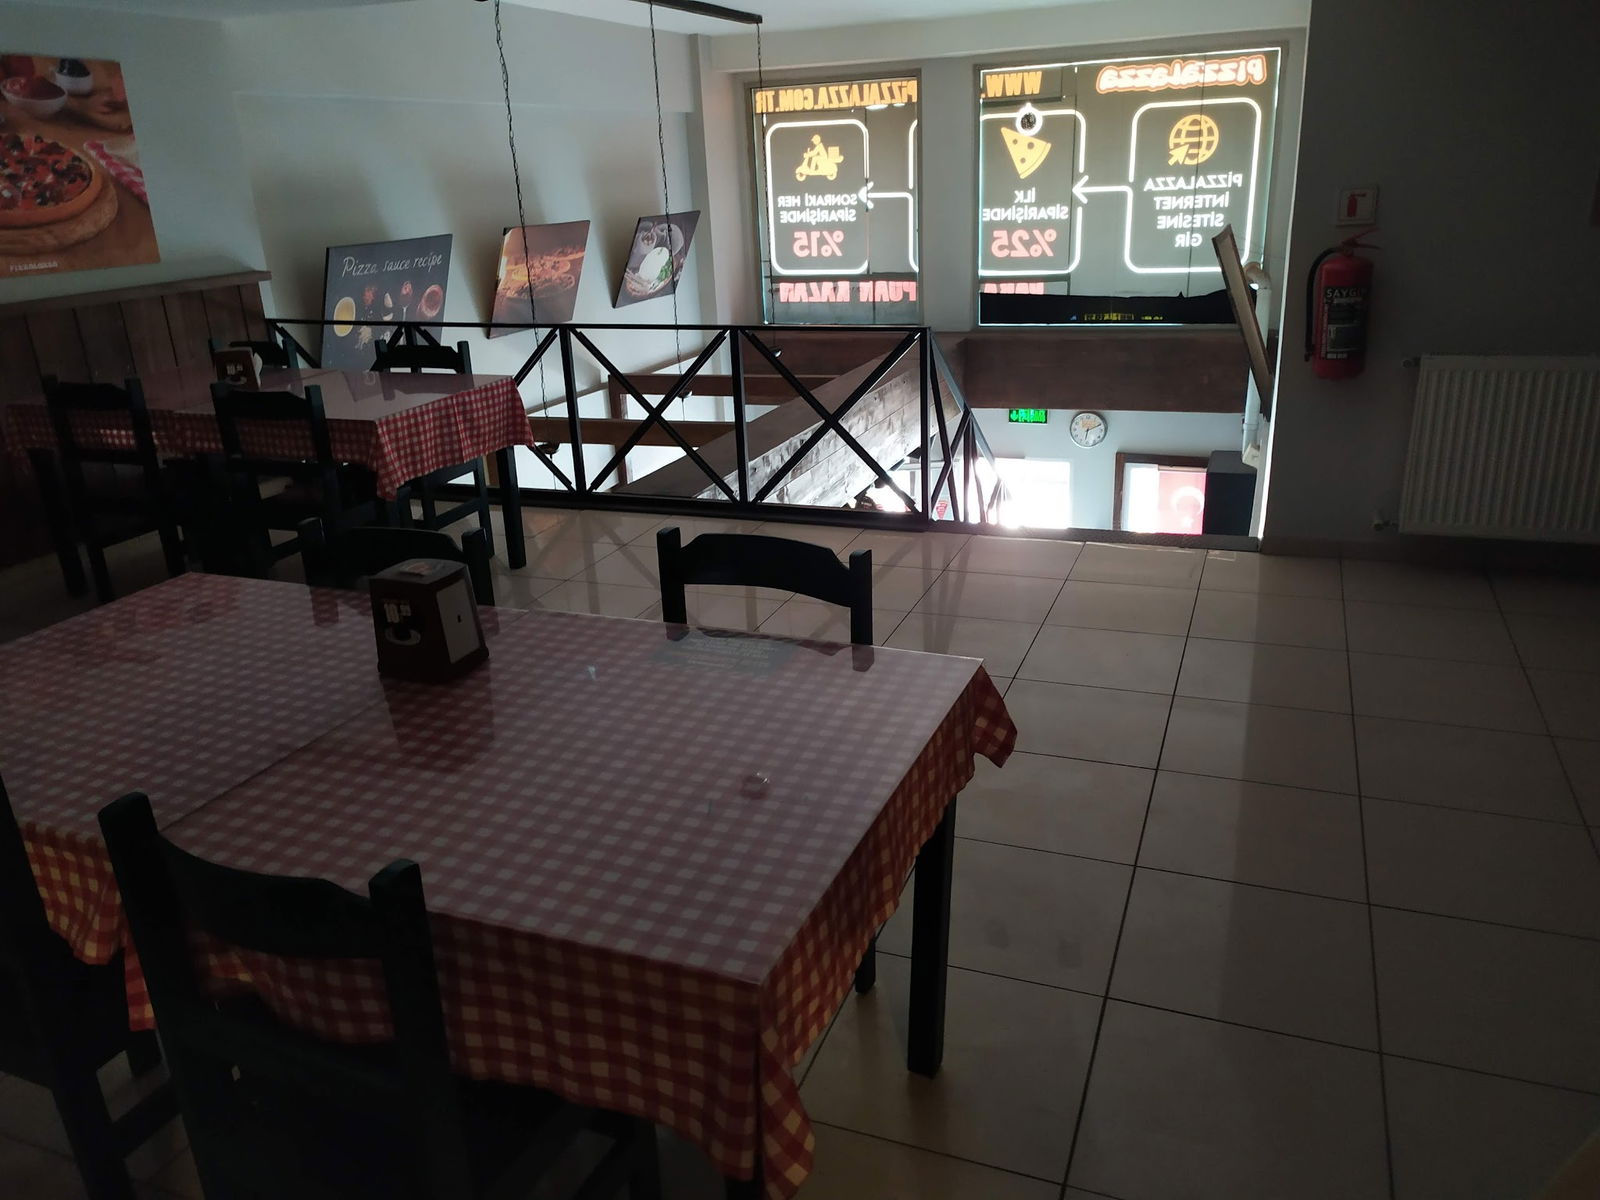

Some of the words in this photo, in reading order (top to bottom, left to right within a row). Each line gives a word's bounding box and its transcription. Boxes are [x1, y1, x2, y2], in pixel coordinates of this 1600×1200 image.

[341, 256, 378, 278] Pizza
[382, 259, 411, 273] sauce
[412, 252, 442, 272] recipe
